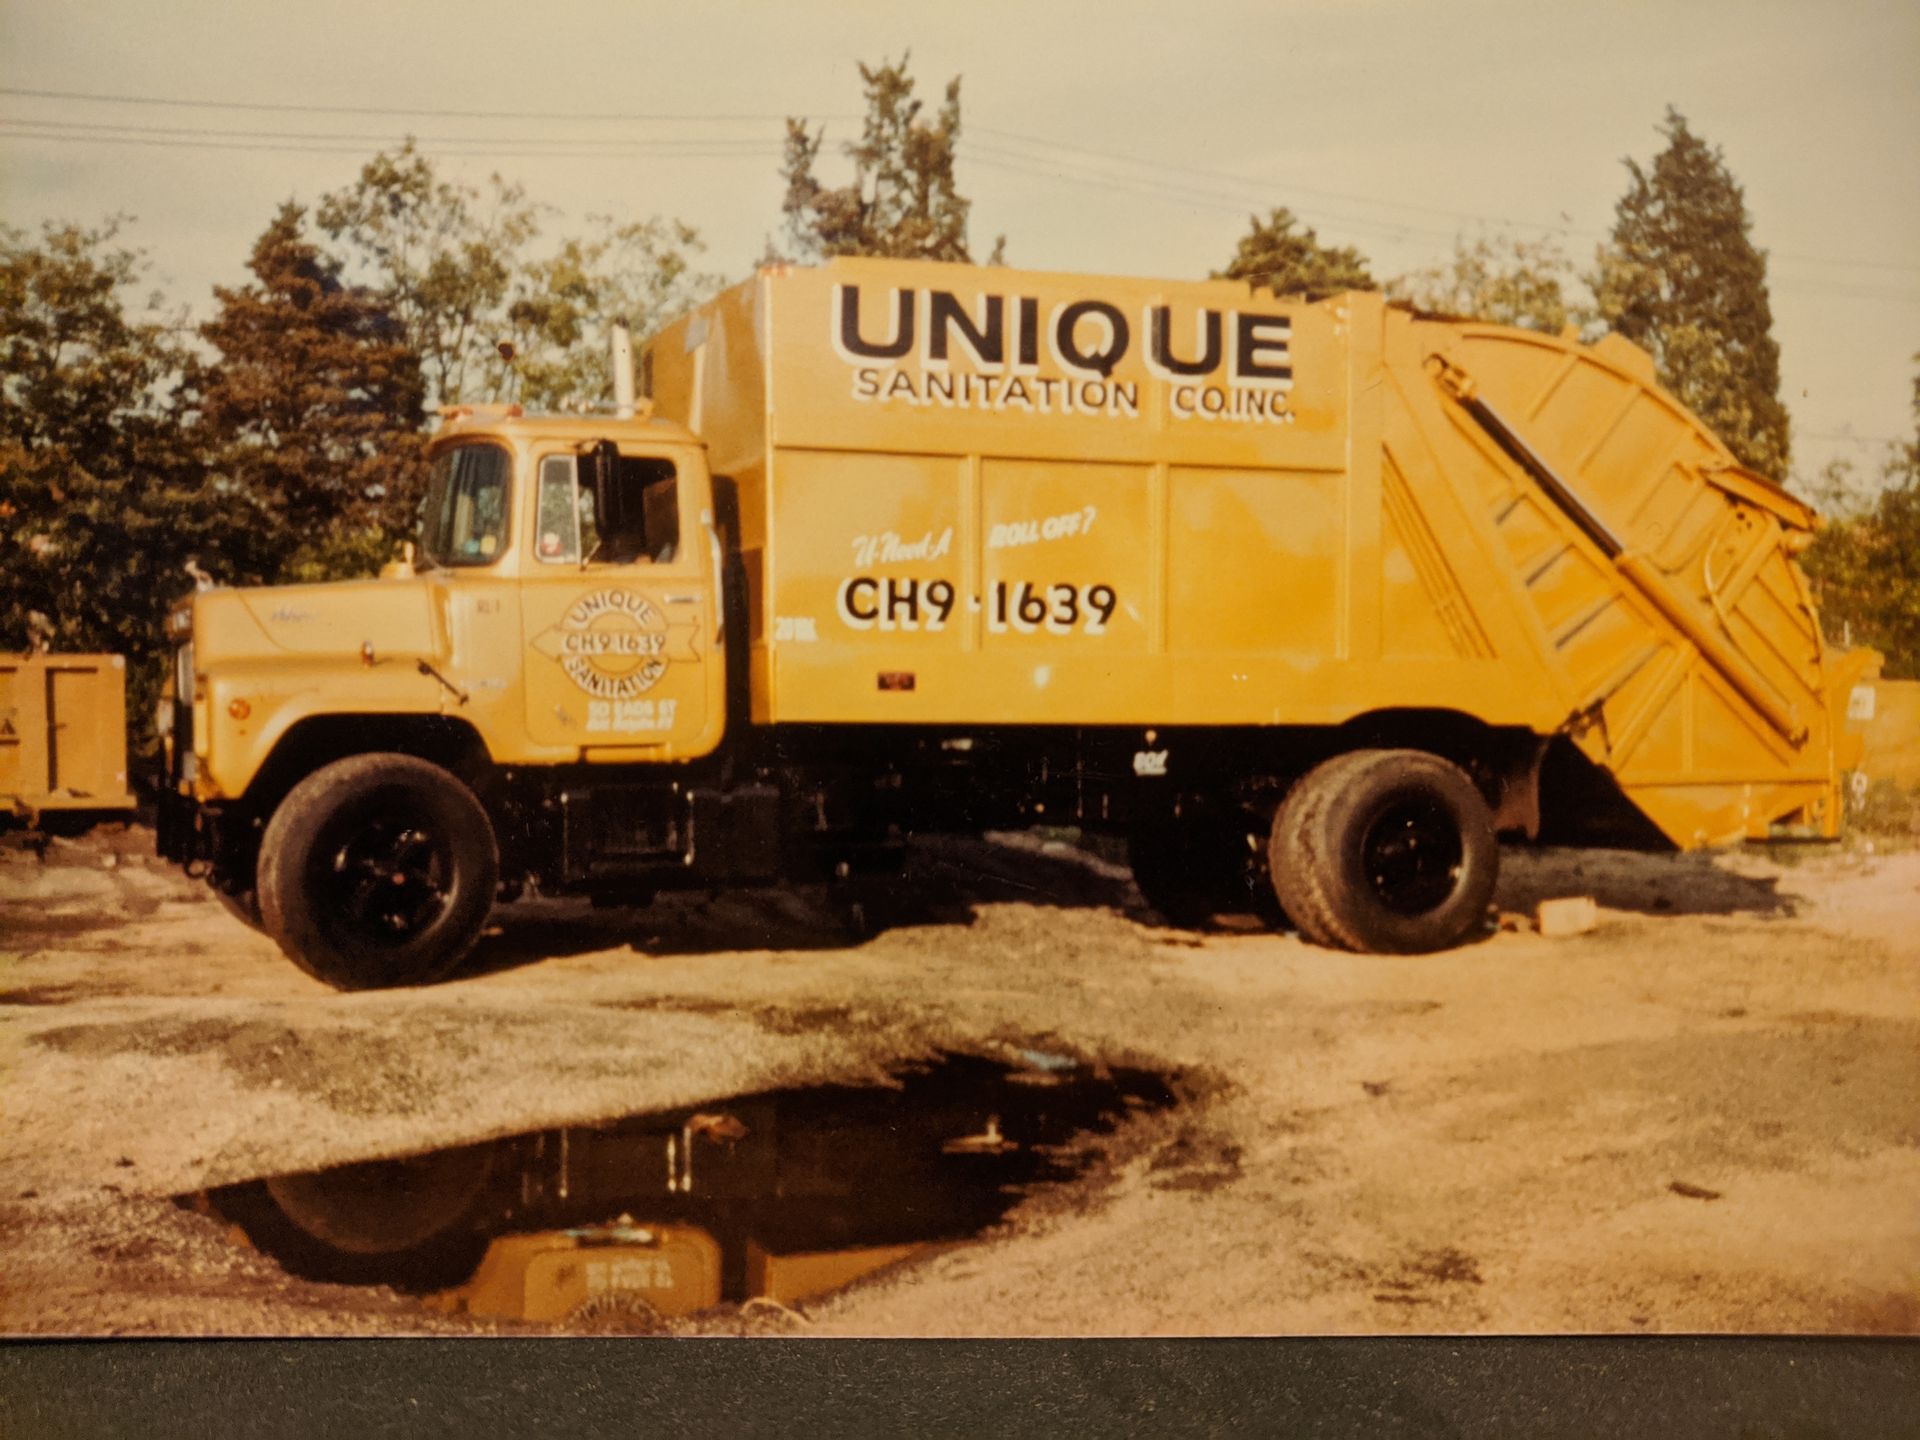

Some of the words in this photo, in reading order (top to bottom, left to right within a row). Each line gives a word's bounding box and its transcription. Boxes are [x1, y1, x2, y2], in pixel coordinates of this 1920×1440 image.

[835, 284, 1293, 382] UNIQUE
[855, 368, 1139, 412] SANITATION
[571, 588, 657, 625] UNIQUE
